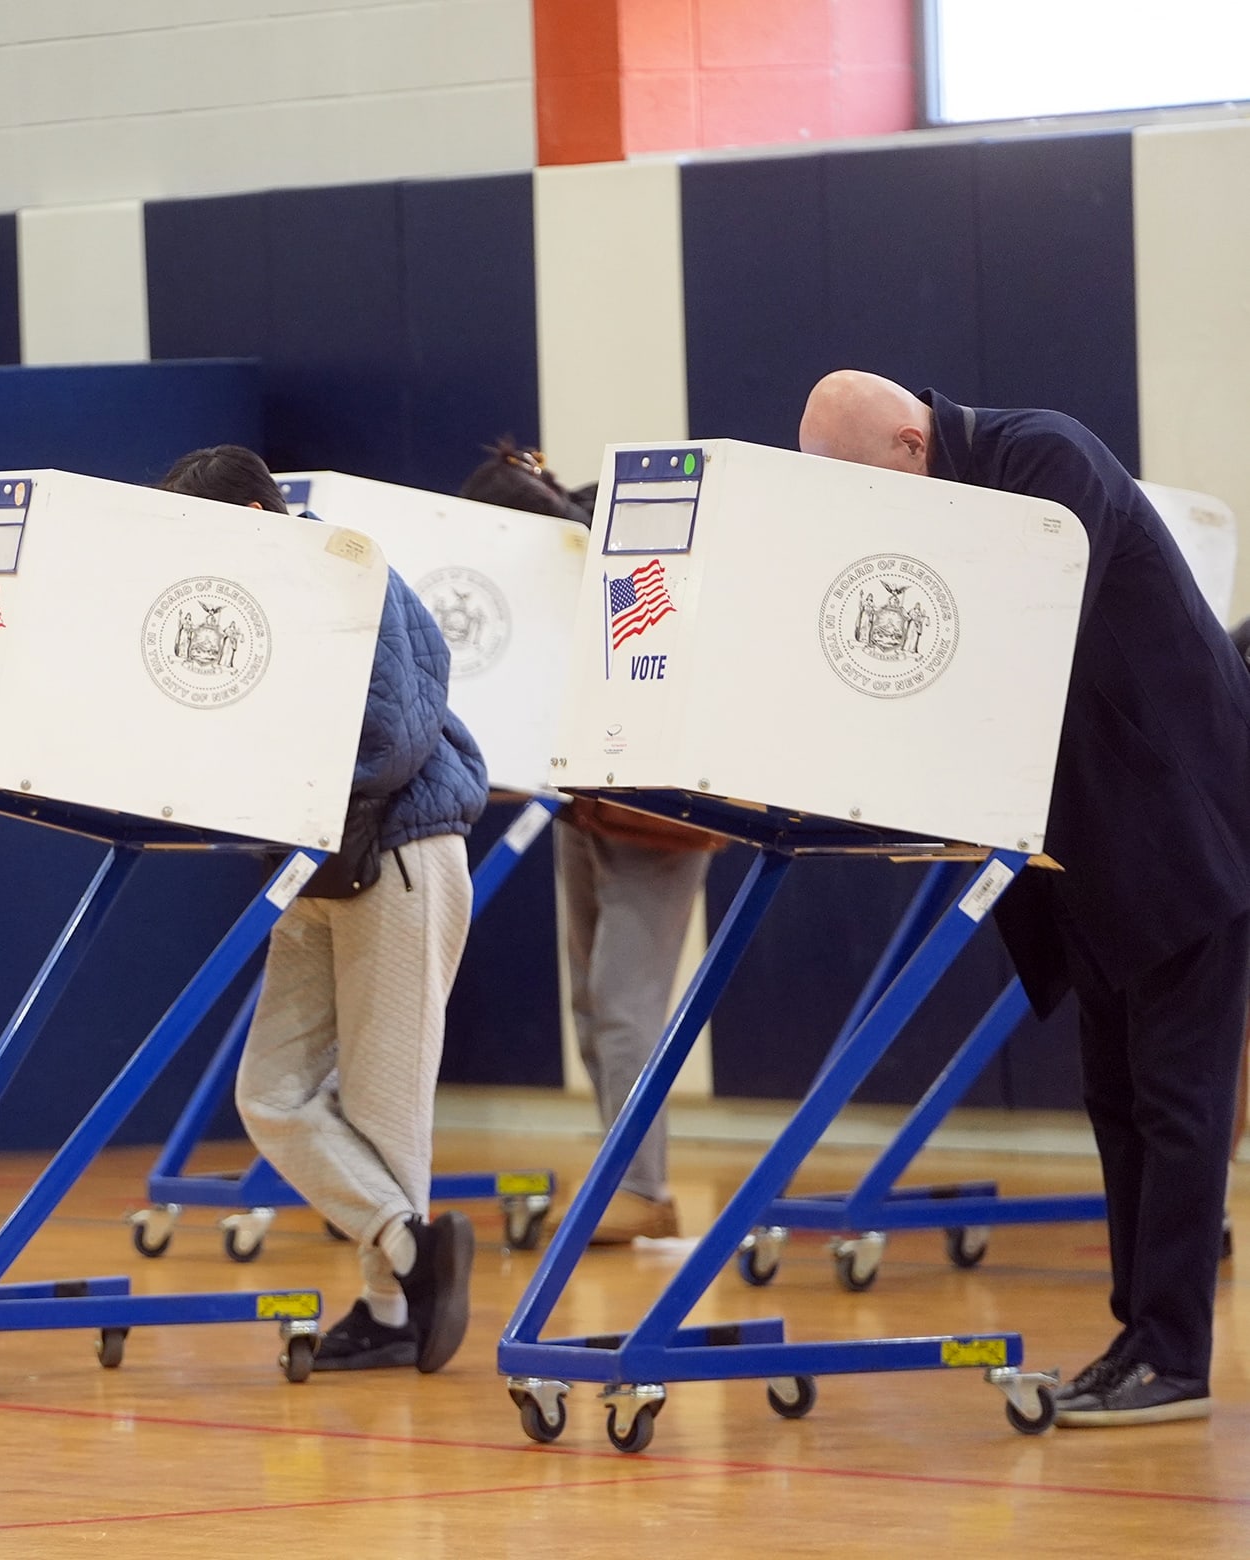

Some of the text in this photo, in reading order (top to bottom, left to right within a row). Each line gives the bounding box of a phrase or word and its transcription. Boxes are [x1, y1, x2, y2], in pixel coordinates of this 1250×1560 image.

[833, 560, 952, 621] BOARD OF ELECTIONS
[154, 581, 265, 638] BOARD OF ELECTIONS
[825, 614, 836, 630] IN
[827, 632, 844, 662] THE
[924, 638, 951, 673] YORK
[191, 693, 208, 702] OF
[212, 684, 239, 702] NEW
[240, 654, 264, 685] YORK
[631, 655, 667, 680] VOTE
[841, 662, 871, 686] CITY
[894, 671, 925, 691] NEW
[872, 681, 892, 691] OF
